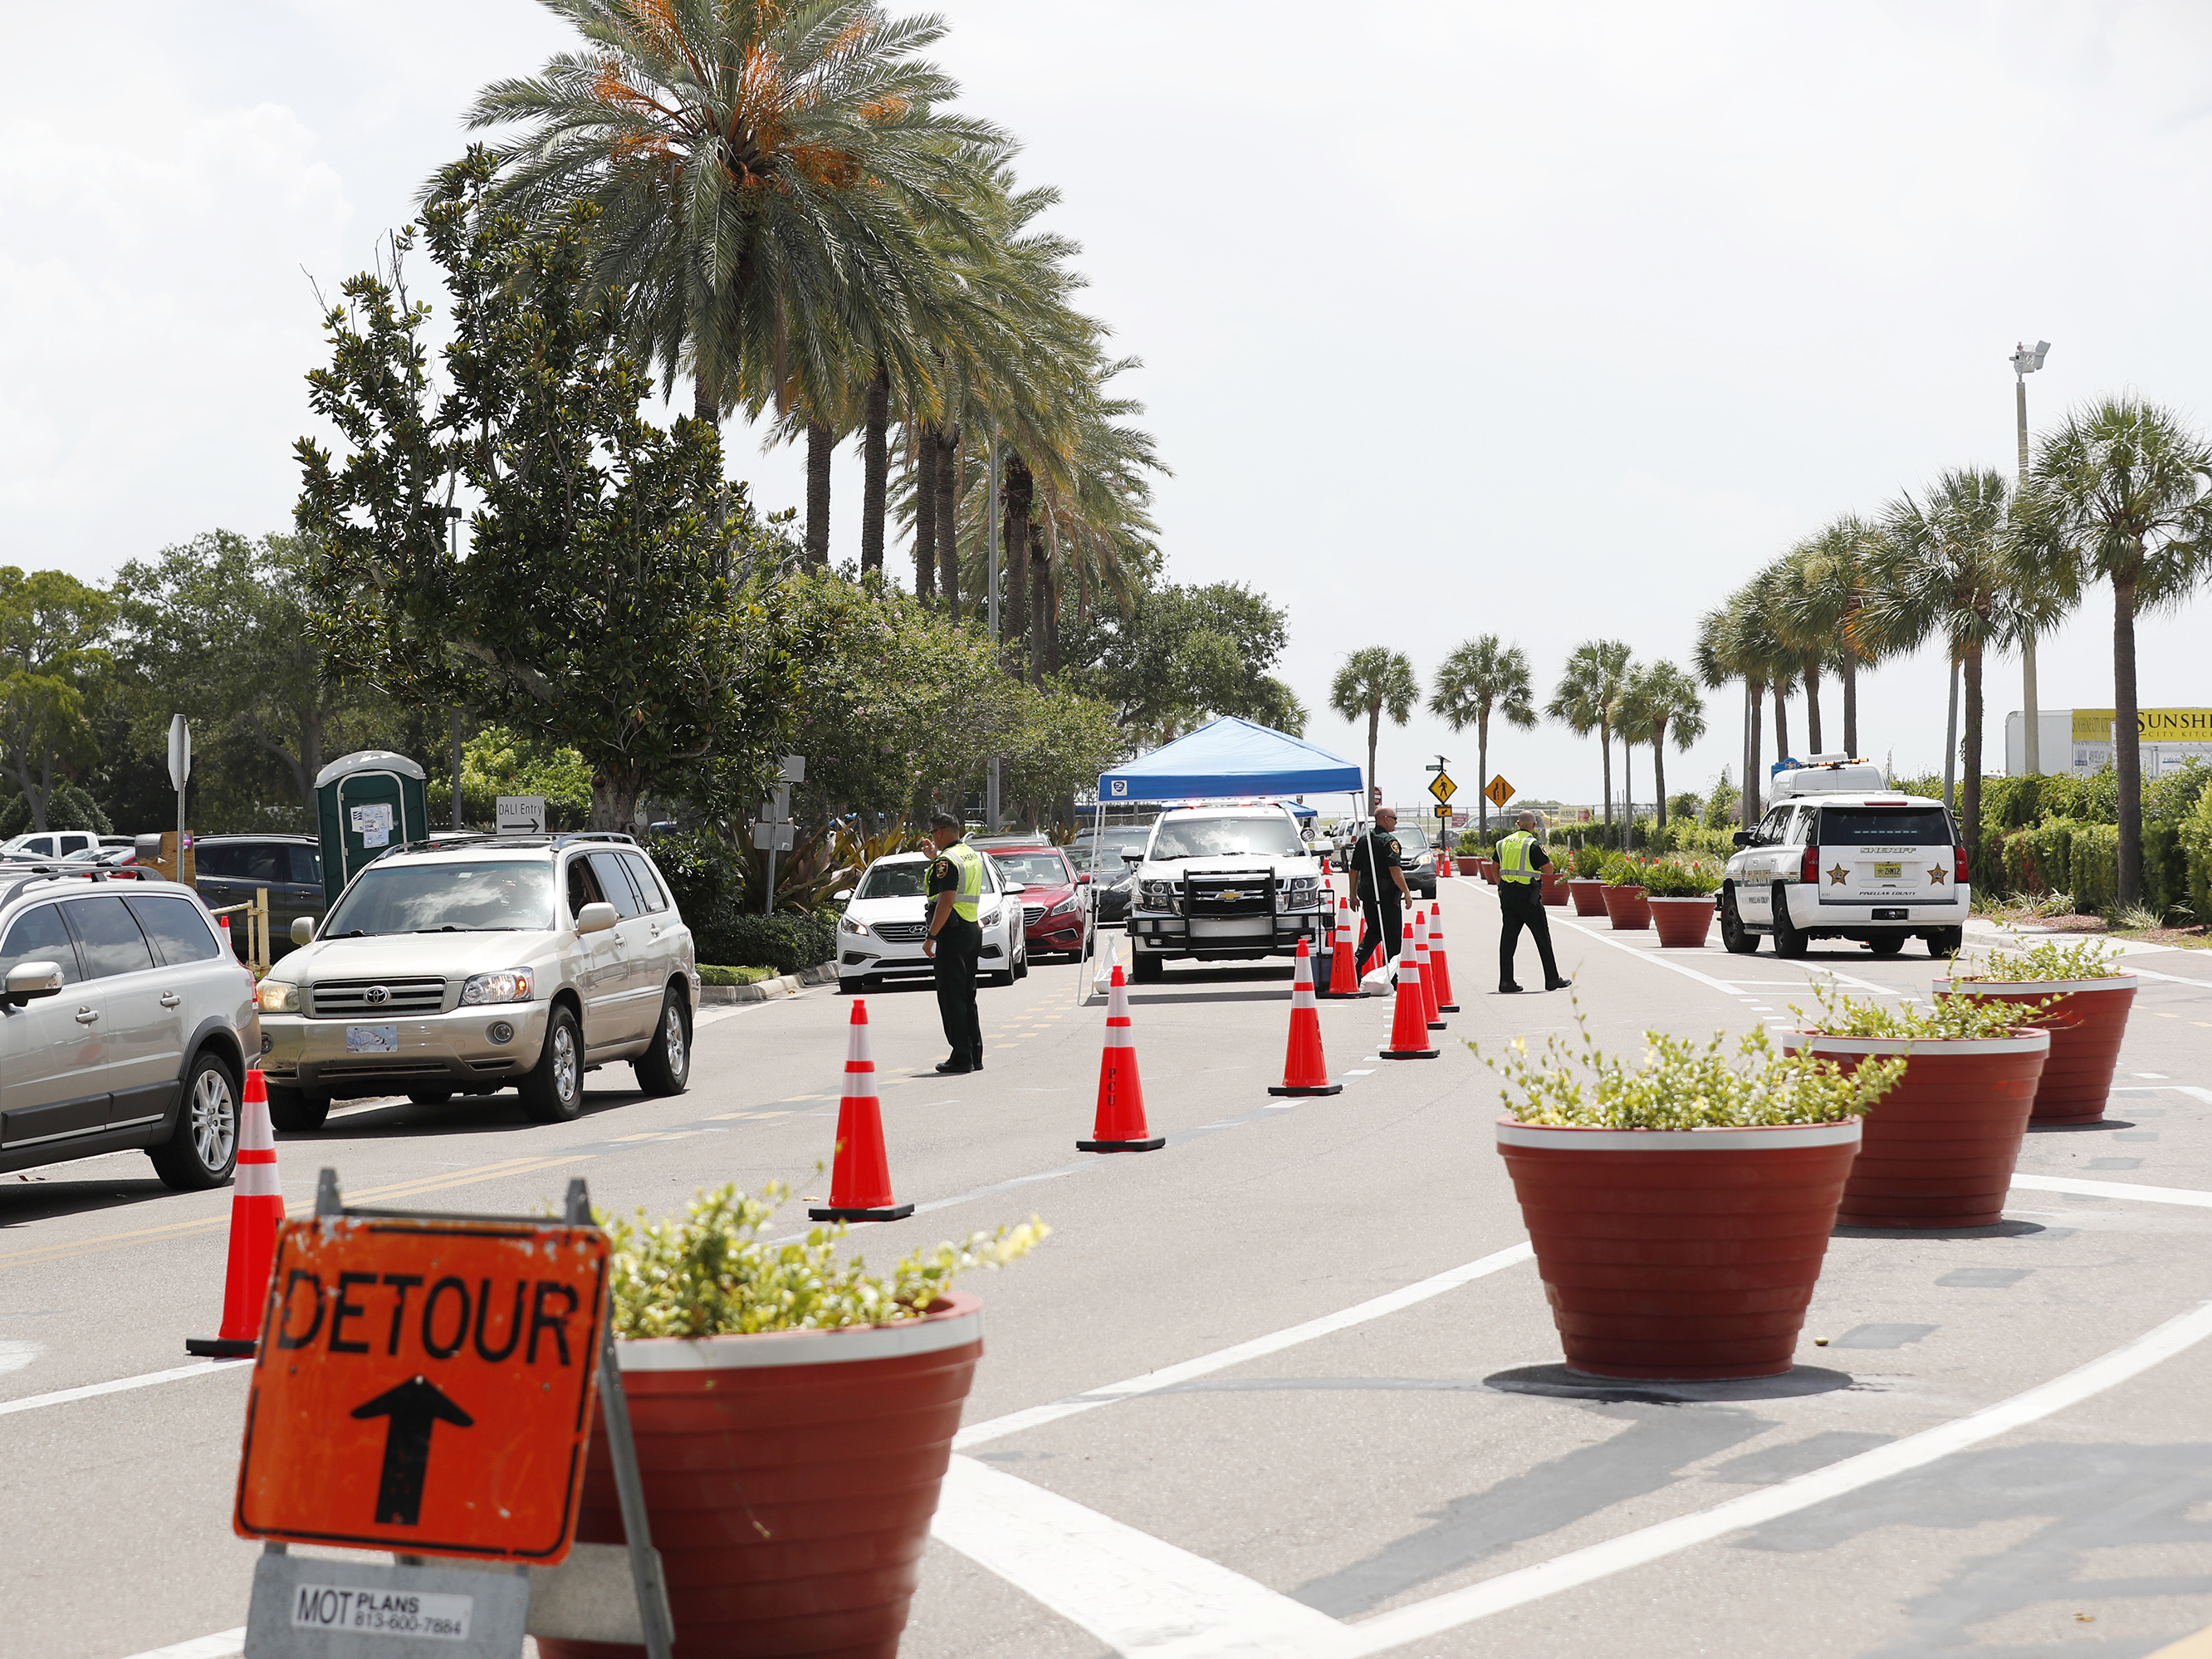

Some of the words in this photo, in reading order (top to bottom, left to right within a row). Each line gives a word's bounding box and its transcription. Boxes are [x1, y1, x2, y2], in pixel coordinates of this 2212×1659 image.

[498, 804, 517, 815] DALI
[521, 803, 542, 816] Entry
[1747, 869, 1771, 884] SHERIFF
[1108, 1068, 1117, 1106] PCU
[277, 1269, 578, 1366] DETOUR
[297, 1588, 353, 1624] MOT
[357, 1593, 419, 1613] PLANS
